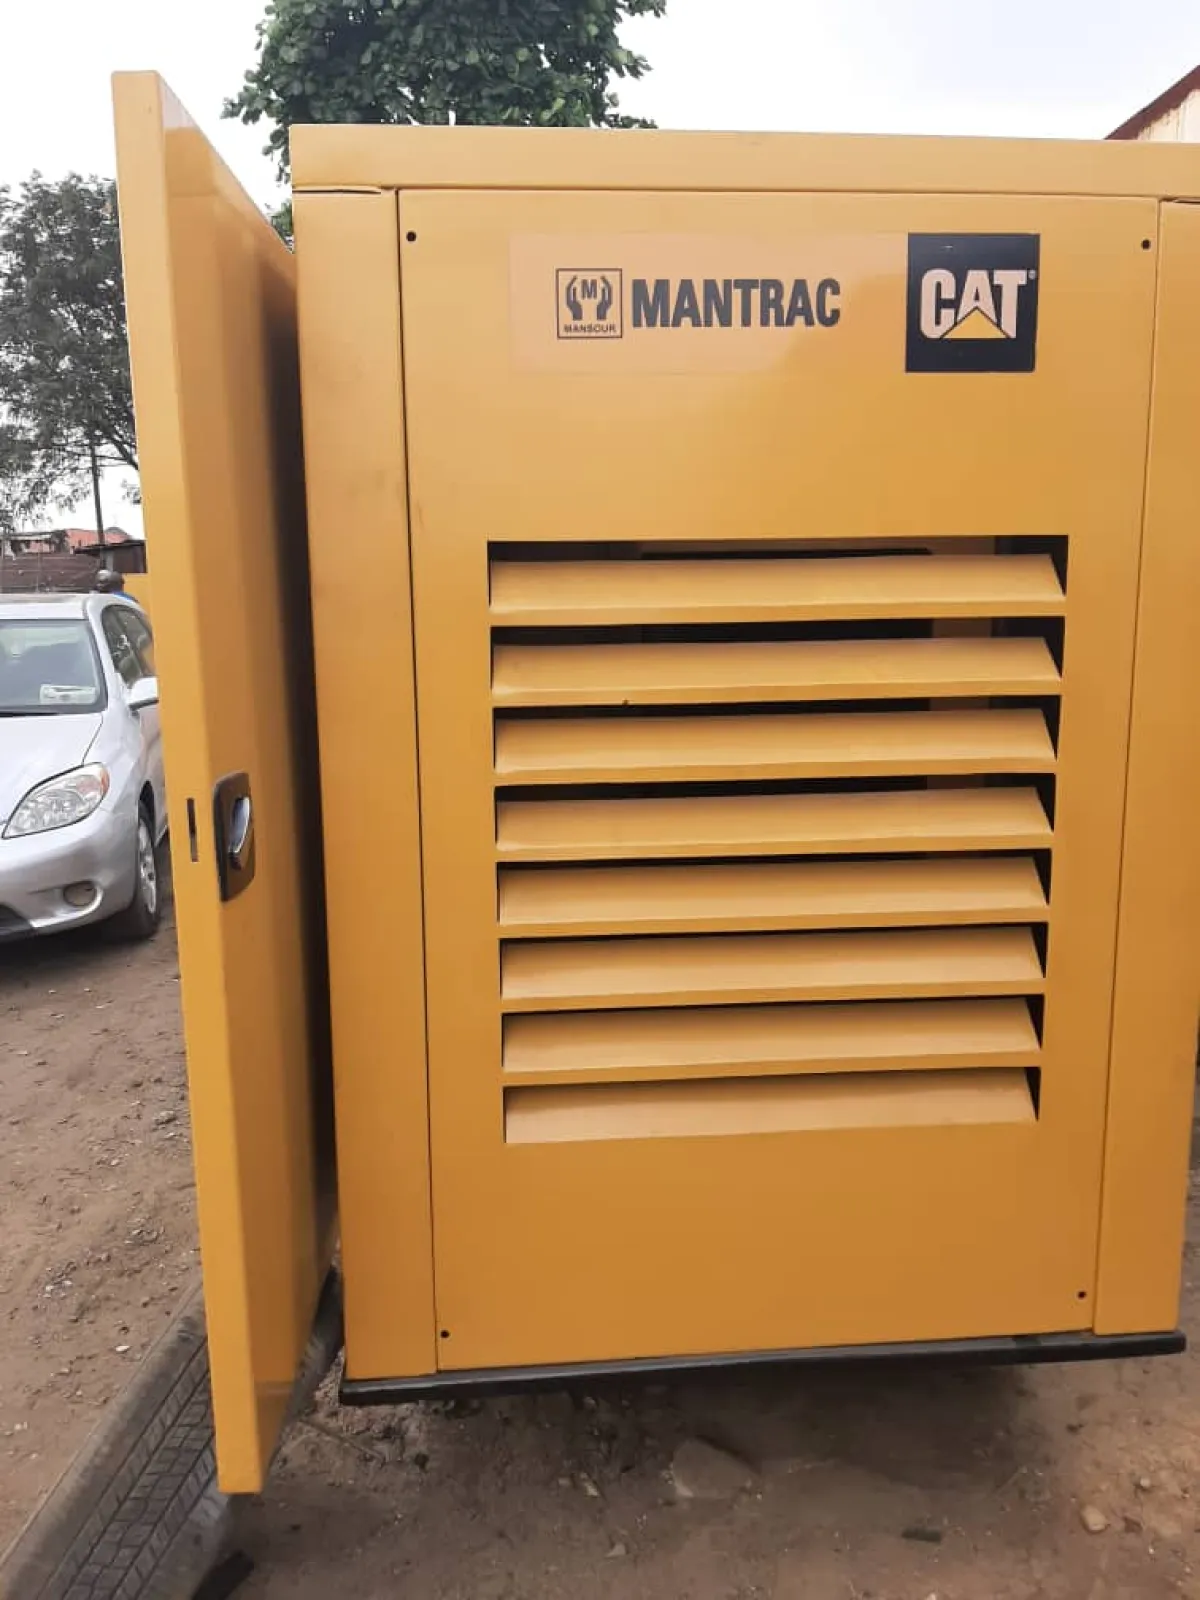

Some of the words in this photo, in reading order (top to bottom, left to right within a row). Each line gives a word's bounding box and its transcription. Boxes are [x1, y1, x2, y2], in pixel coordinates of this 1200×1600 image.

[581, 279, 598, 300] M
[632, 278, 841, 328] MANTRAC
[920, 268, 1028, 339] CAT
